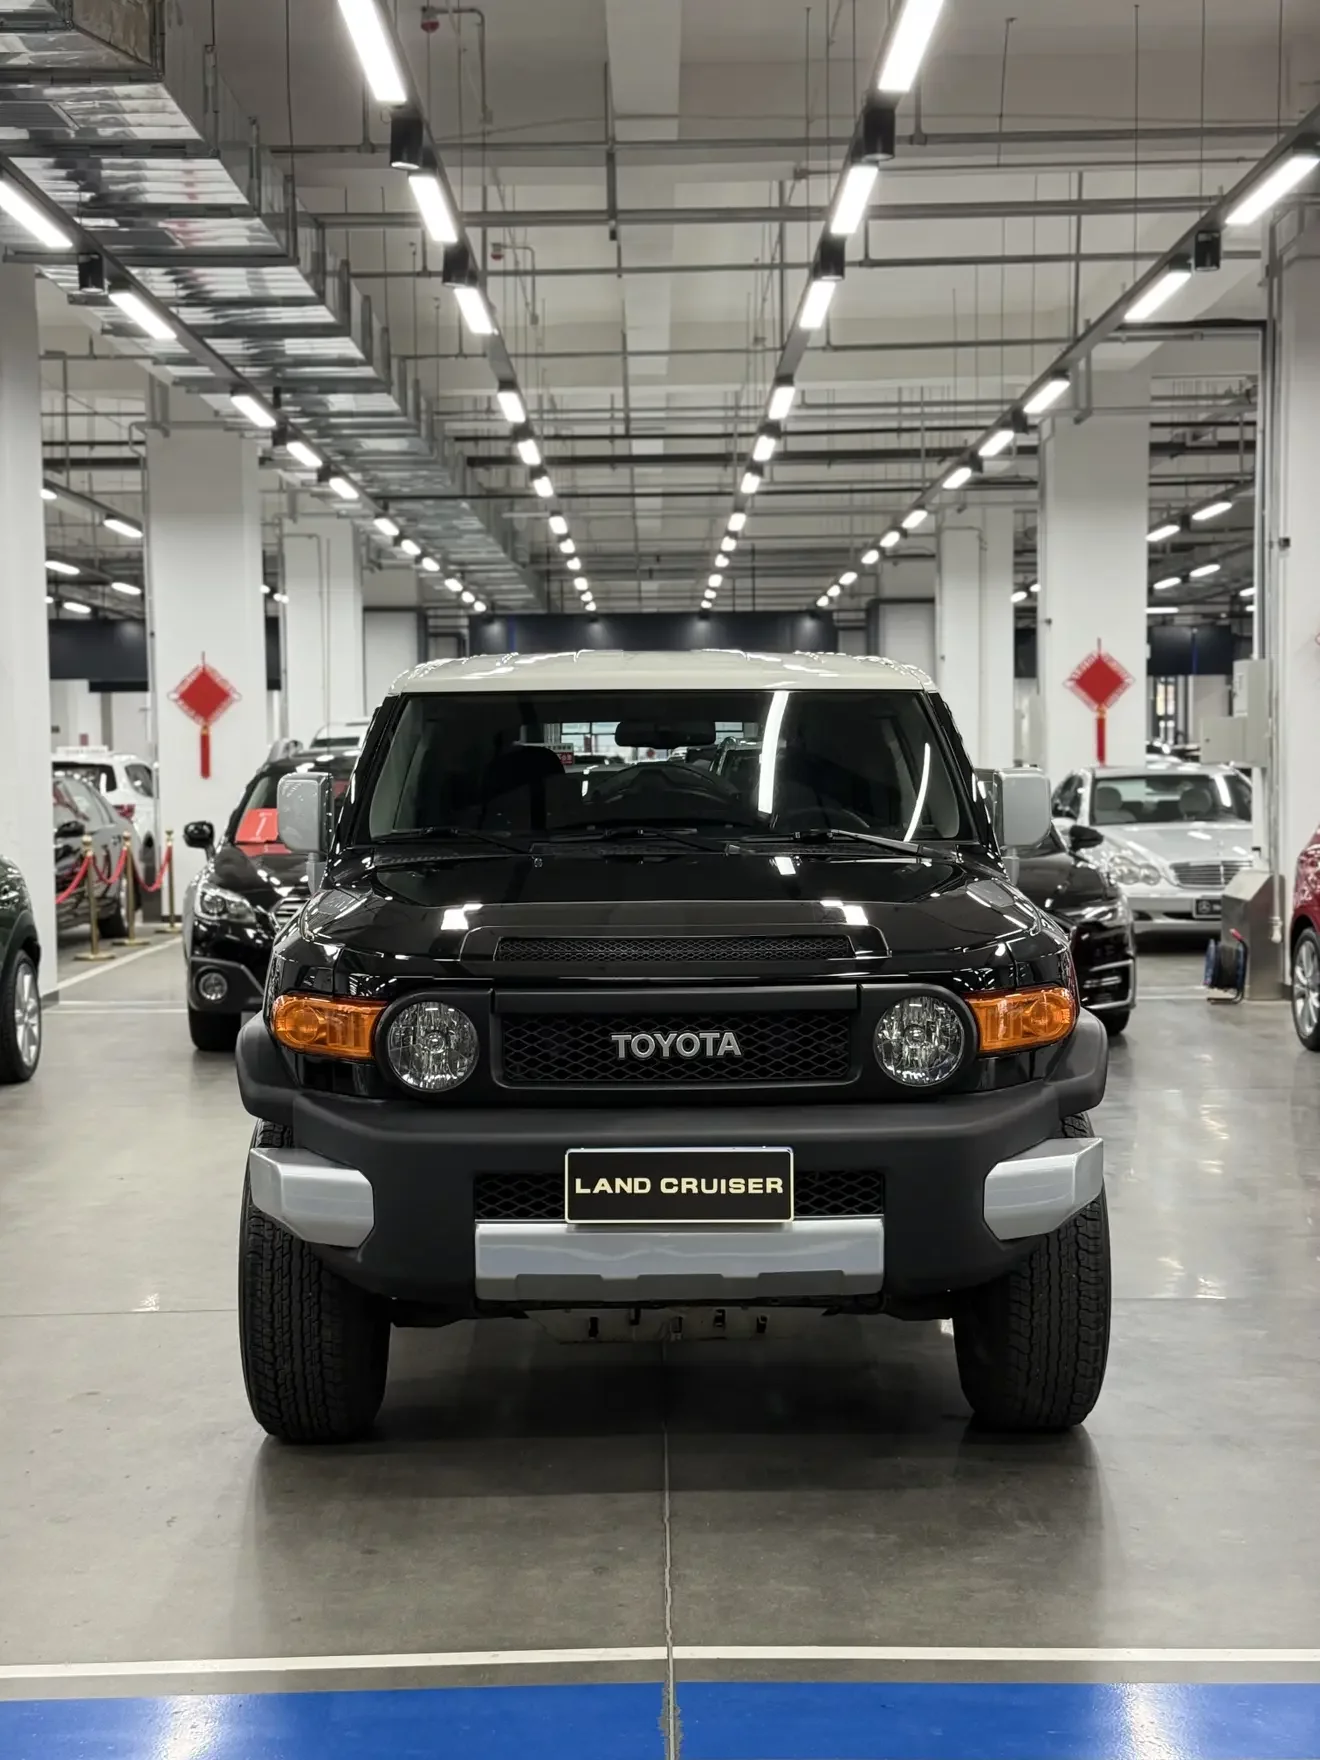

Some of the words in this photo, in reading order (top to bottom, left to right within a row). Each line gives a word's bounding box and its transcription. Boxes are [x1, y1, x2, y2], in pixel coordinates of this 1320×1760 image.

[611, 1032, 742, 1059] TOYOTA
[575, 1177, 651, 1194] LAND
[660, 1177, 784, 1194] CRUISER
